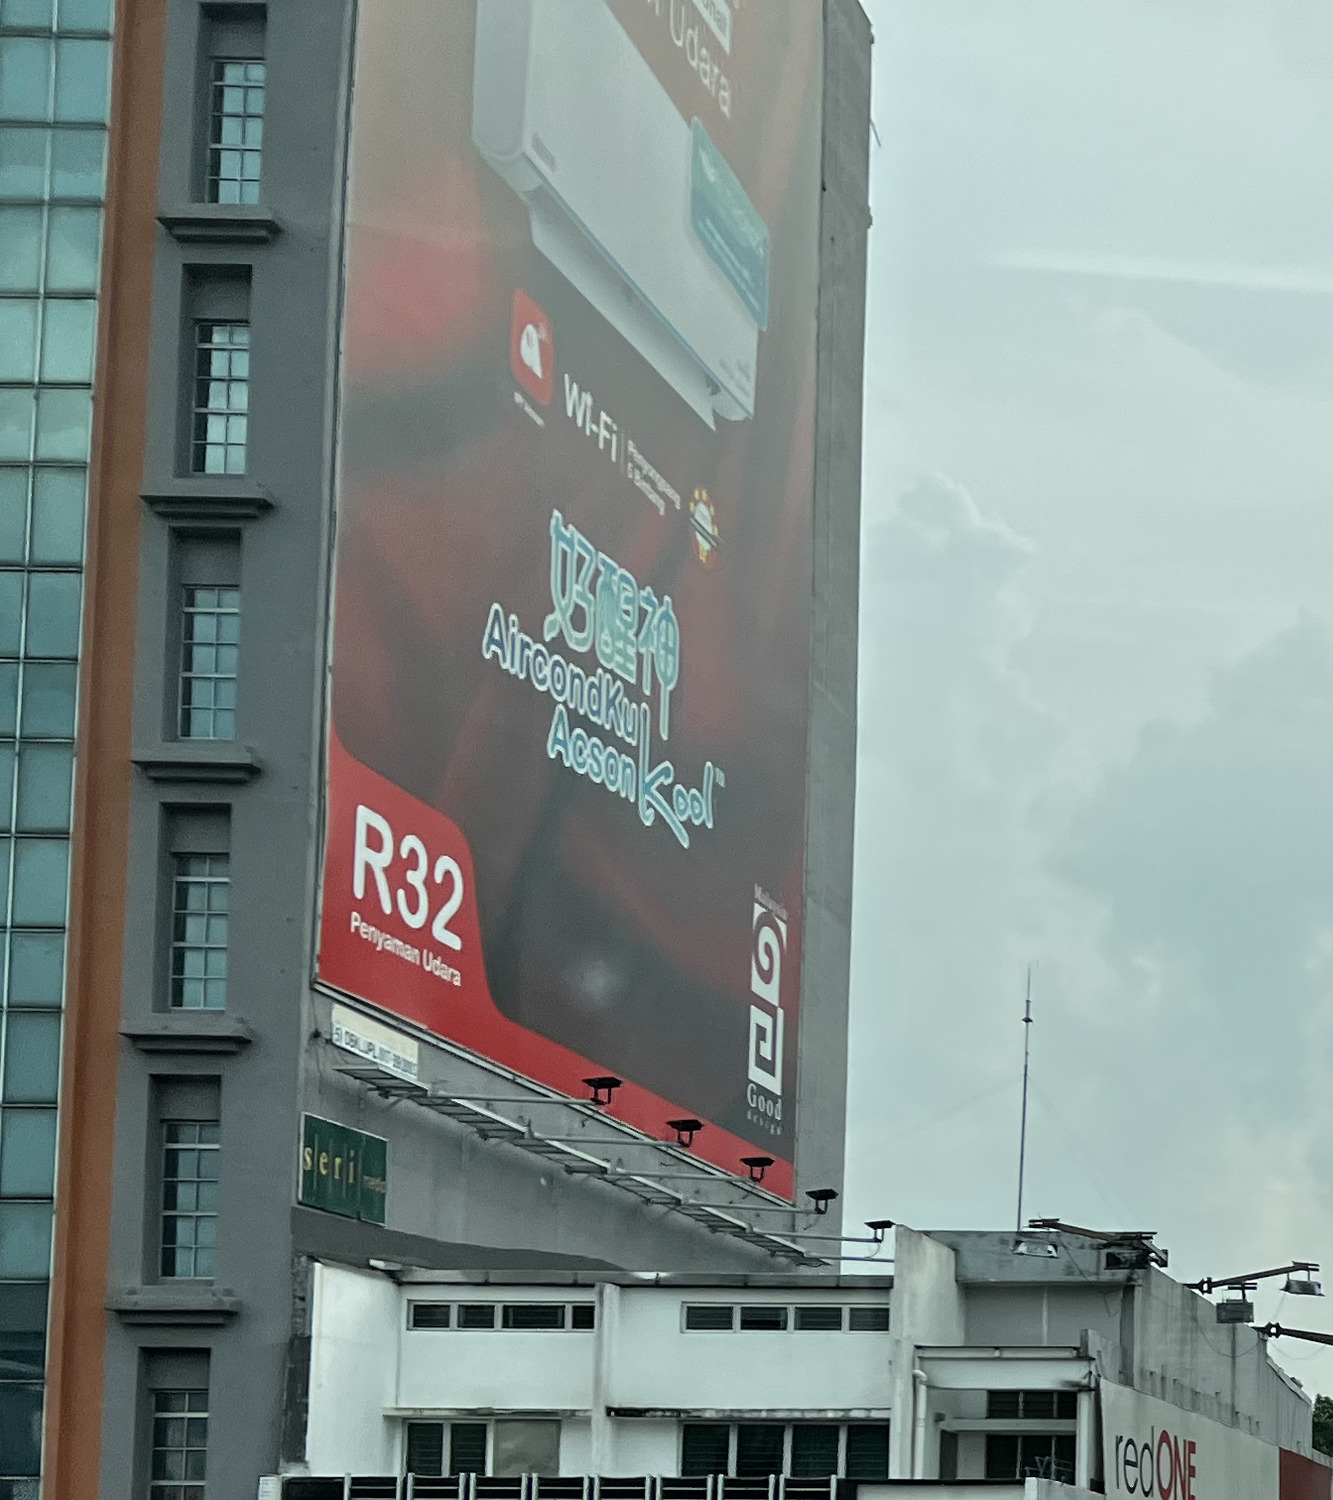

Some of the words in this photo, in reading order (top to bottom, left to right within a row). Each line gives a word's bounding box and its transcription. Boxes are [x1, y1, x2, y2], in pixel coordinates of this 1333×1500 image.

[352, 804, 464, 951] R32
[350, 911, 421, 967] Penyaman
[422, 946, 461, 986] Udara
[747, 1083, 782, 1120] Good
